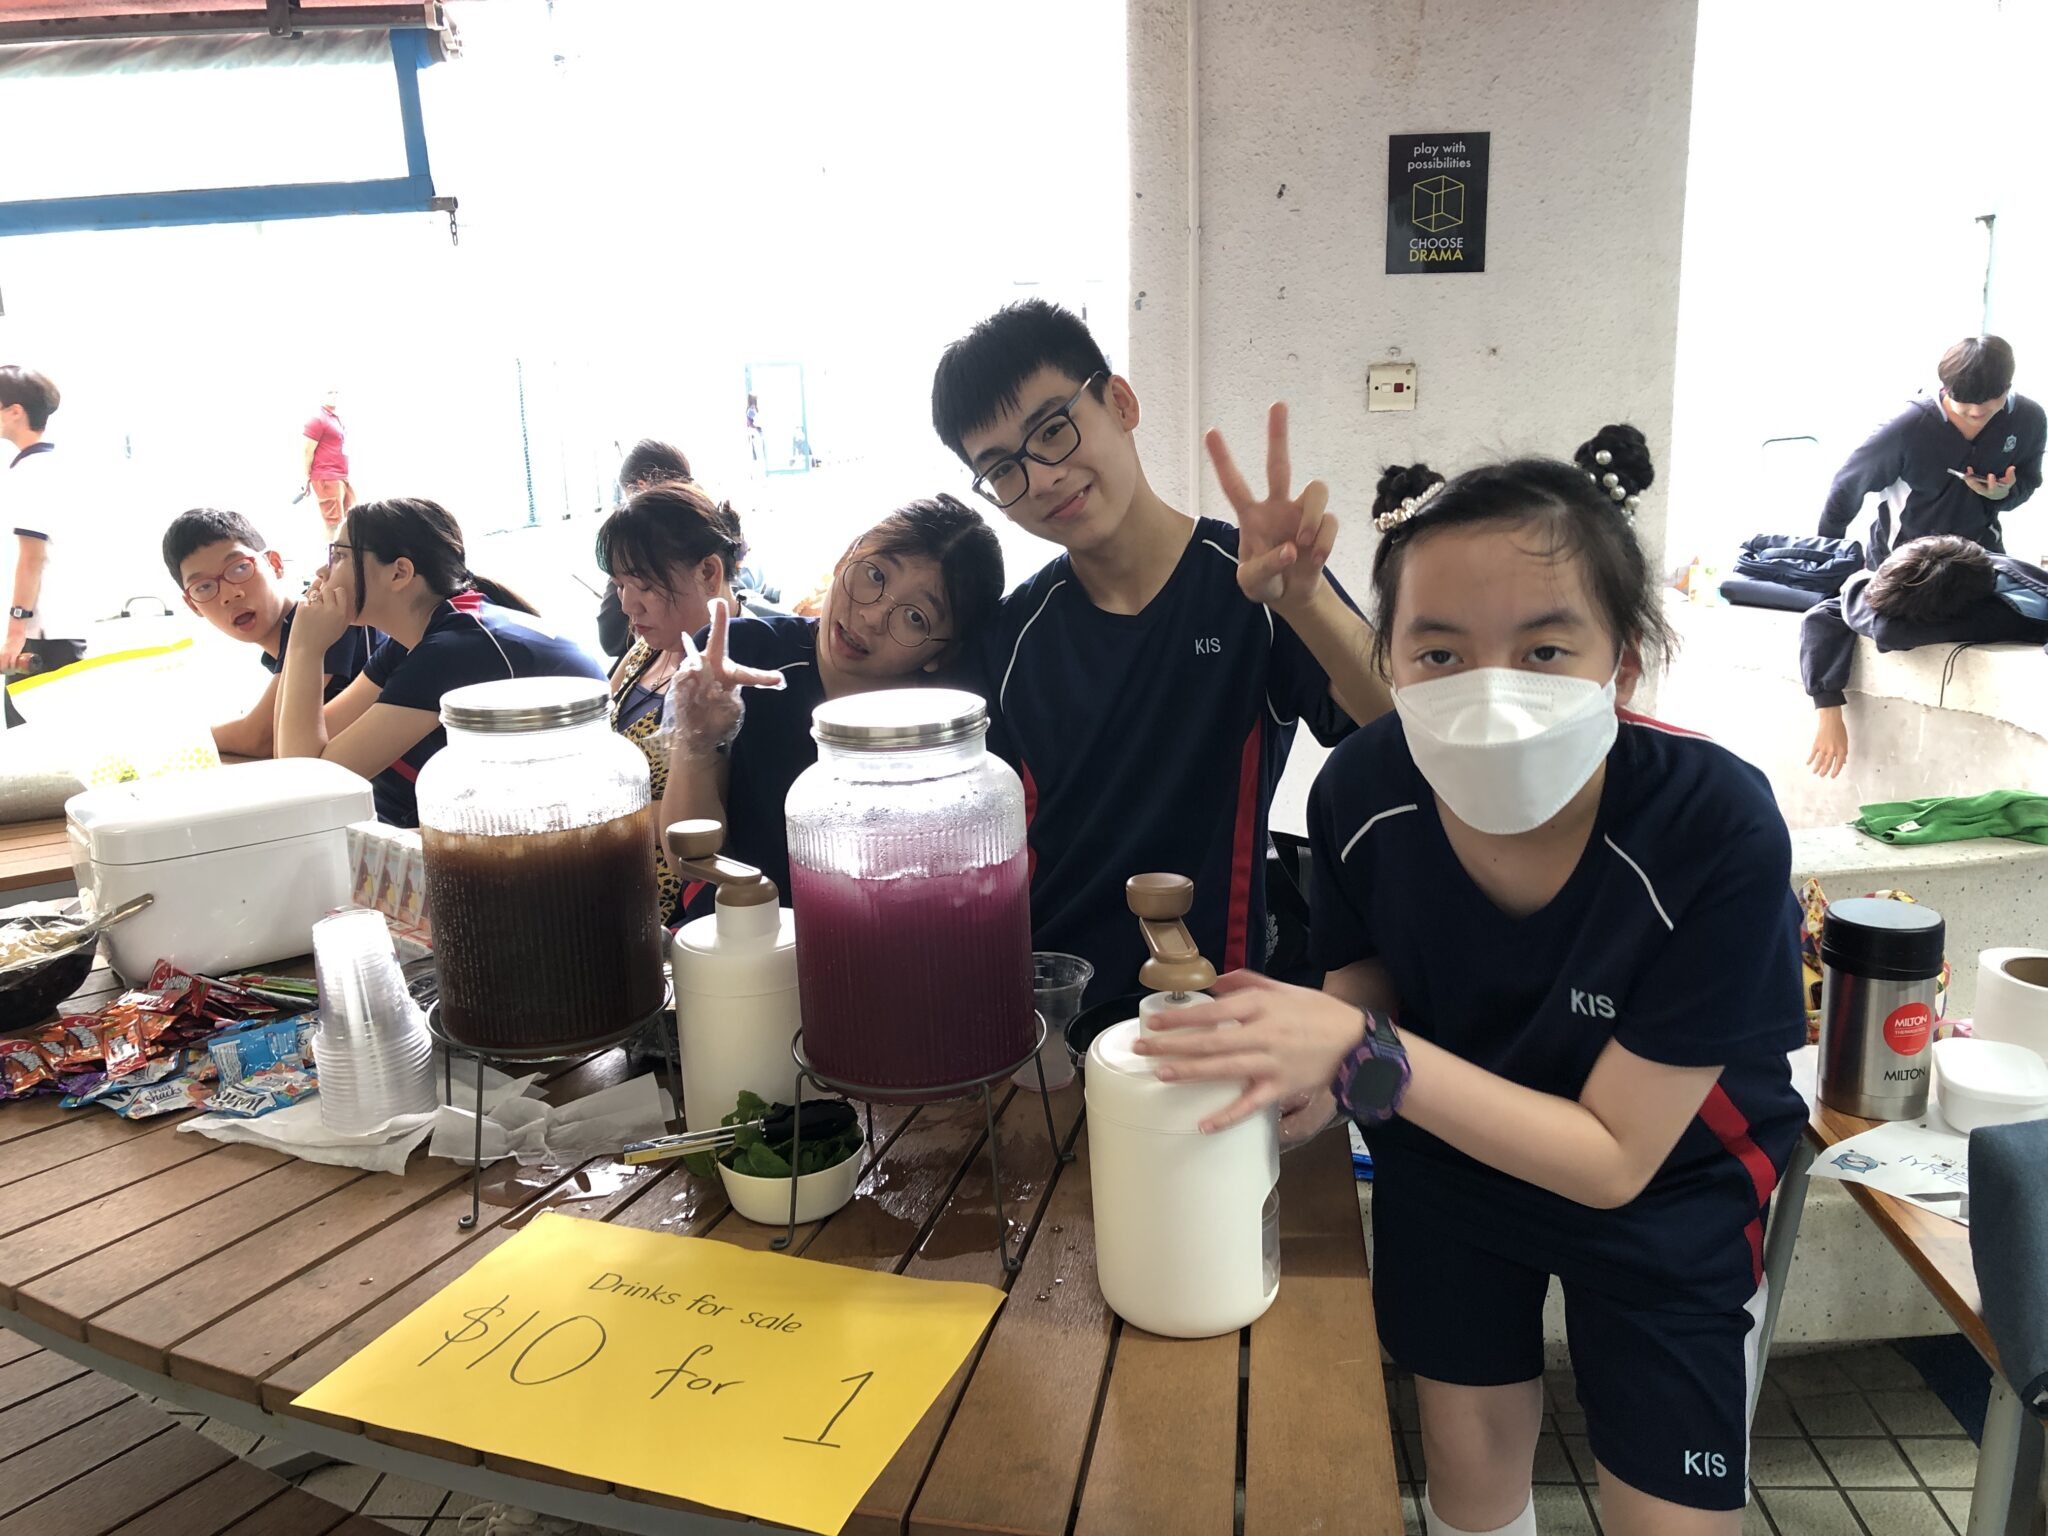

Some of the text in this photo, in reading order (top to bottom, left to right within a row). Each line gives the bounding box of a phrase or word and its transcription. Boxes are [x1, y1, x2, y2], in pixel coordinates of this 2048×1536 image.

[1413, 141, 1466, 157] play with
[1407, 156, 1472, 173] possibilities
[1409, 237, 1464, 249] CHOOSE
[1409, 248, 1464, 262] DRAMA
[1194, 637, 1222, 655] KIS
[1570, 987, 1616, 1019] KIS
[1894, 1014, 1928, 1028] MILTON
[1884, 1066, 1926, 1081] MILTON
[587, 1272, 803, 1334] Drinks for sale
[417, 1294, 874, 1449] $10 for 1
[1684, 1449, 1728, 1478] KIS
